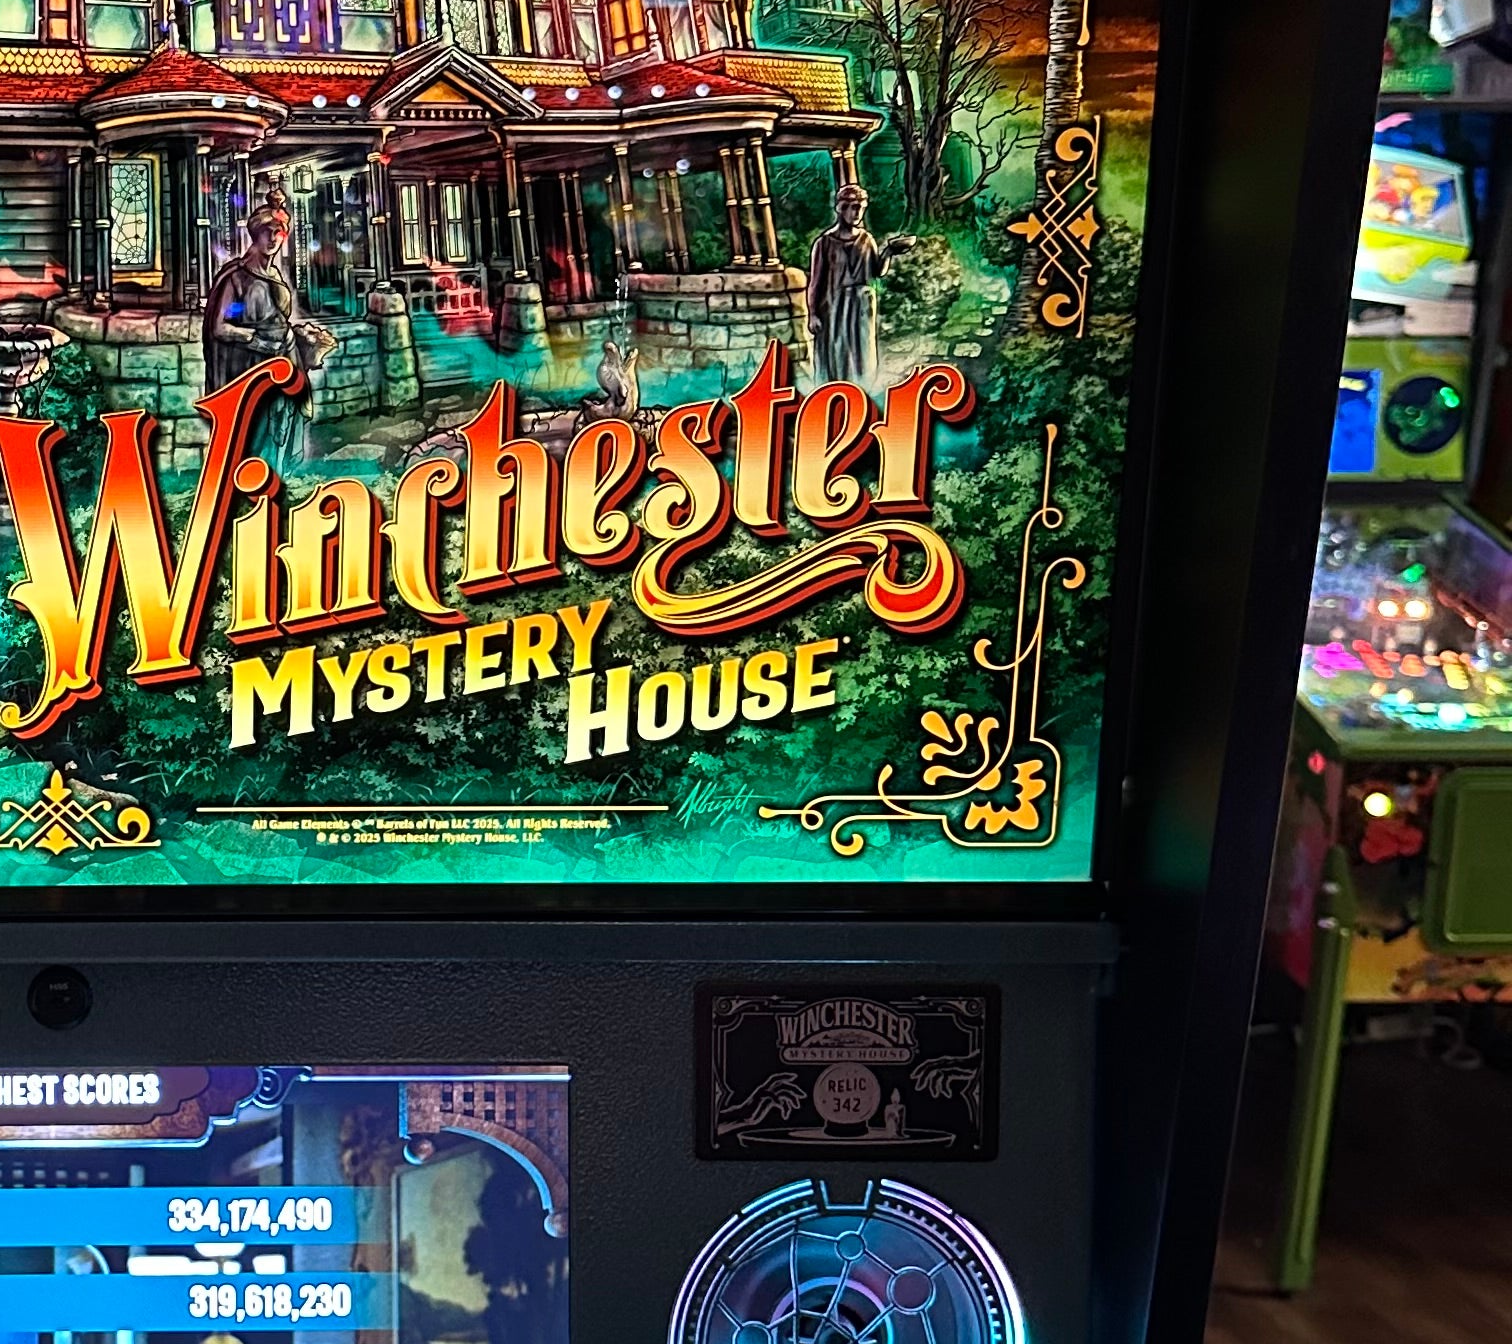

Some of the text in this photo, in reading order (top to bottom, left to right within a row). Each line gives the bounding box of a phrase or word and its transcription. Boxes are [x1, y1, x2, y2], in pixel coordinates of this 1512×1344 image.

[228, 597, 612, 752] MYSTERY
[563, 637, 838, 764] HOUSE
[252, 820, 267, 829] All
[269, 820, 299, 829] Game
[301, 819, 350, 829] Elements
[376, 819, 414, 829] Barrels
[416, 819, 428, 828] of
[451, 819, 470, 828] LLC
[506, 819, 521, 828] All
[523, 818, 558, 830] Rights
[560, 819, 612, 829] Reserved.
[383, 833, 440, 843] Winchester
[442, 833, 482, 845] Mystery
[780, 1001, 915, 1045] WINCHESTER
[789, 1049, 906, 1059] MYSTERY HOUSE
[63, 1074, 159, 1104] SCORES
[828, 1077, 867, 1093] RELIC
[833, 1098, 861, 1113] 342
[168, 1197, 332, 1236] 334,174,490
[189, 1283, 352, 1322] 319,618,230
